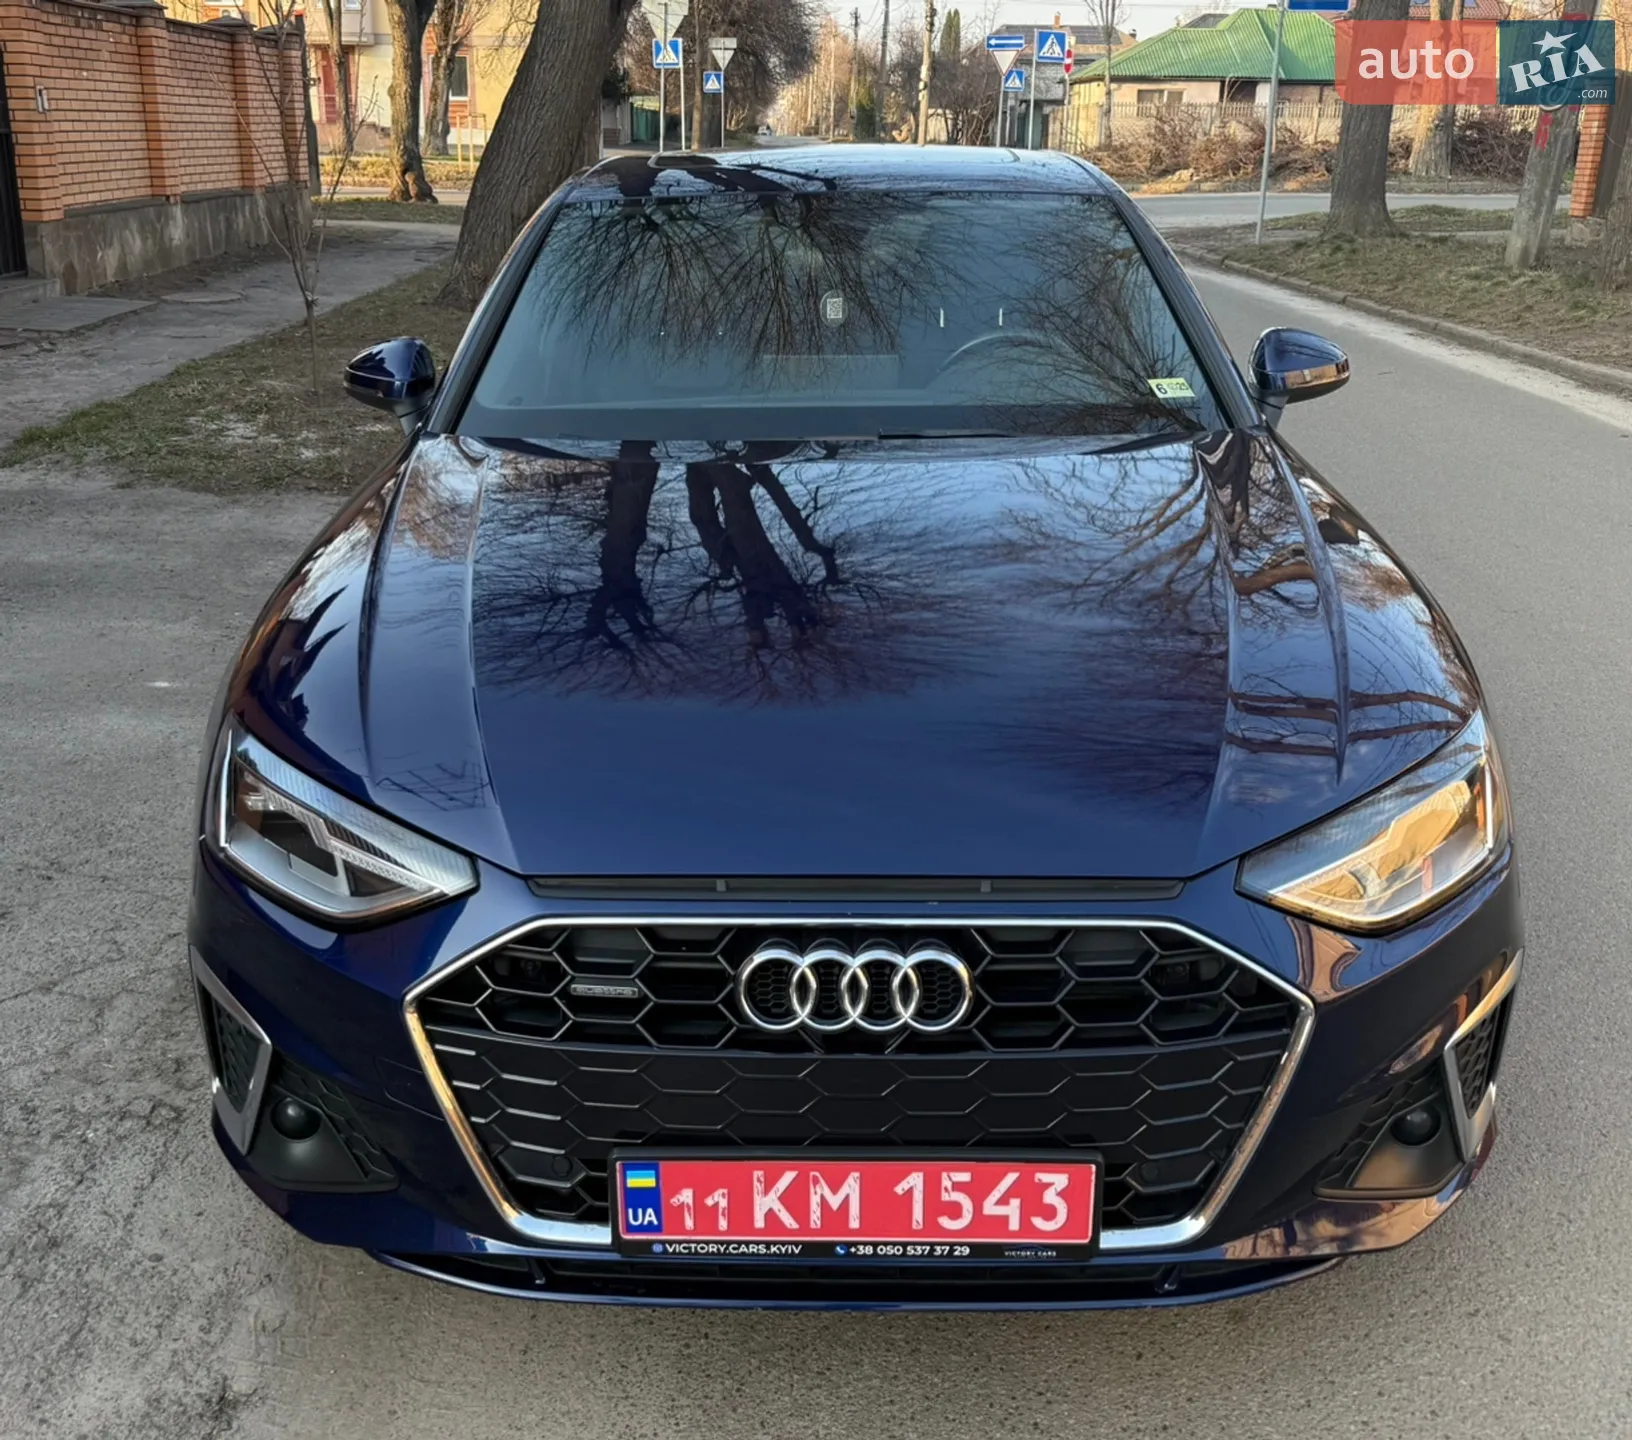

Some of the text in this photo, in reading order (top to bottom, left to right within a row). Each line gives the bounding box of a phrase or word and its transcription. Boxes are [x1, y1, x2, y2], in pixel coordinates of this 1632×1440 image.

[669, 1170, 1069, 1232] 11 KM 1543
[627, 1208, 658, 1226] UA
[665, 1243, 802, 1254] VICTORY.CARS.KYIV
[849, 1245, 970, 1256] +38 050 537 37 29
